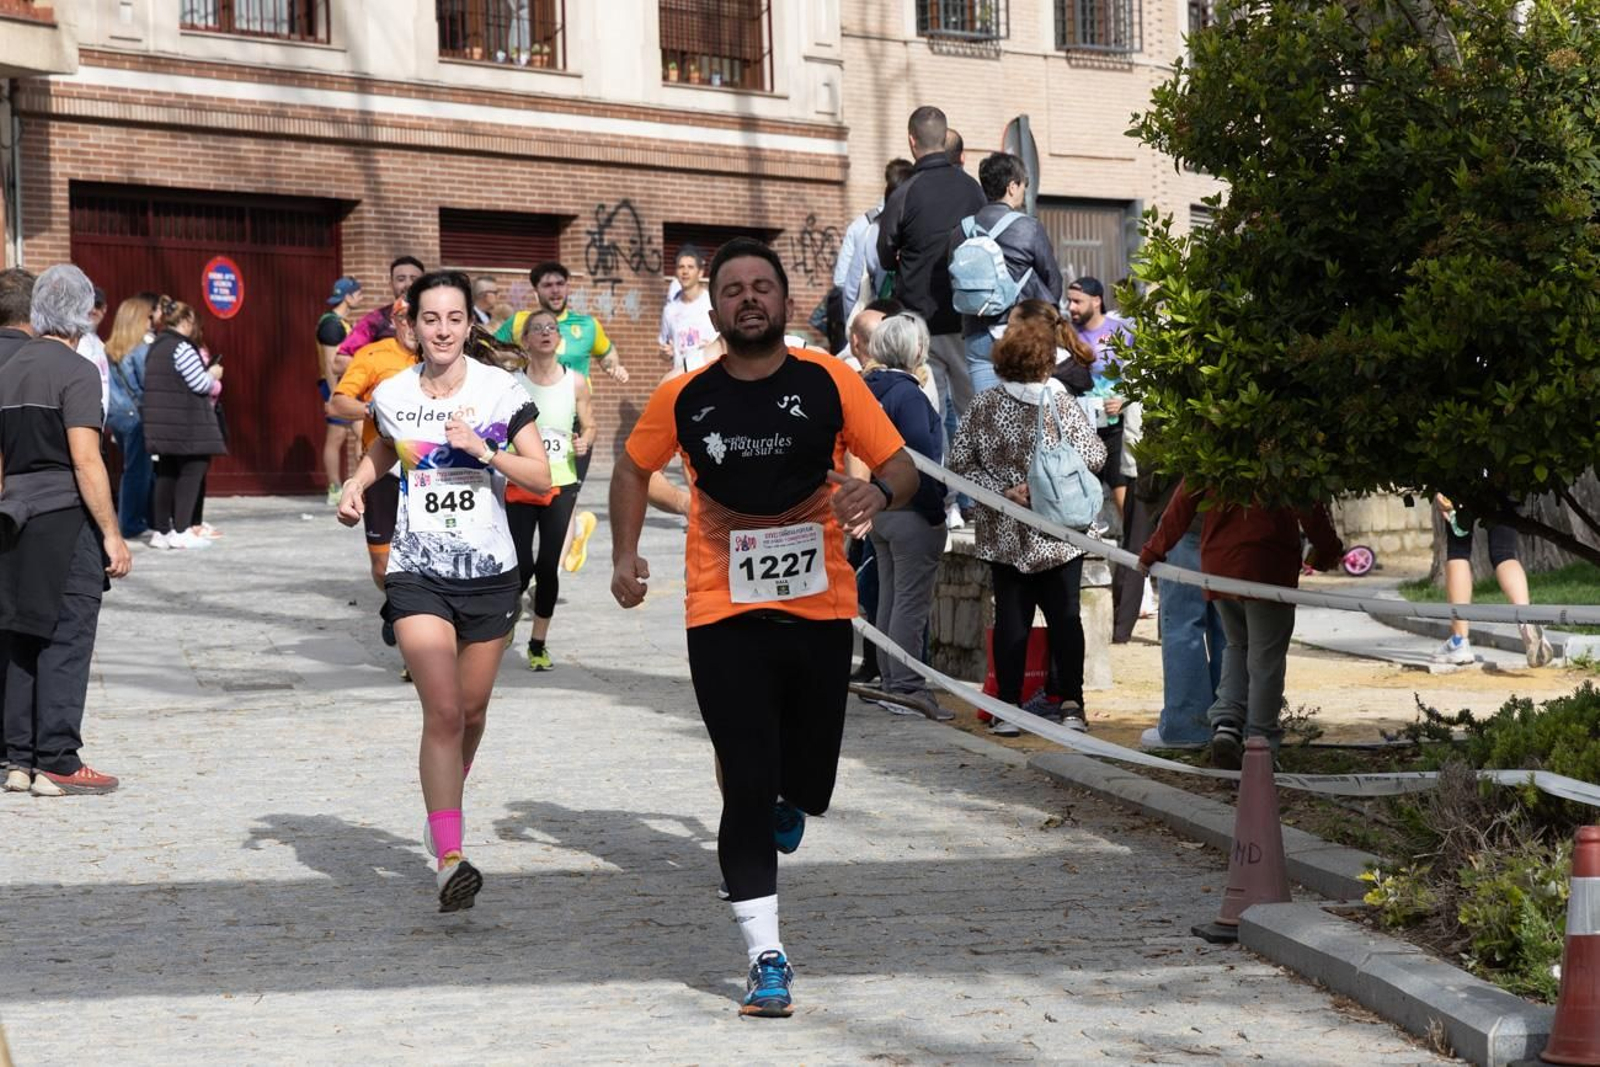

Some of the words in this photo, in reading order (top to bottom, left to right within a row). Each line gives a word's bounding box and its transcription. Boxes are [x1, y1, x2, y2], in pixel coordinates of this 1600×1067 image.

[396, 404, 475, 428] calderón
[730, 432, 792, 451] naturales
[425, 490, 475, 513] 848
[739, 548, 817, 581] 1227
